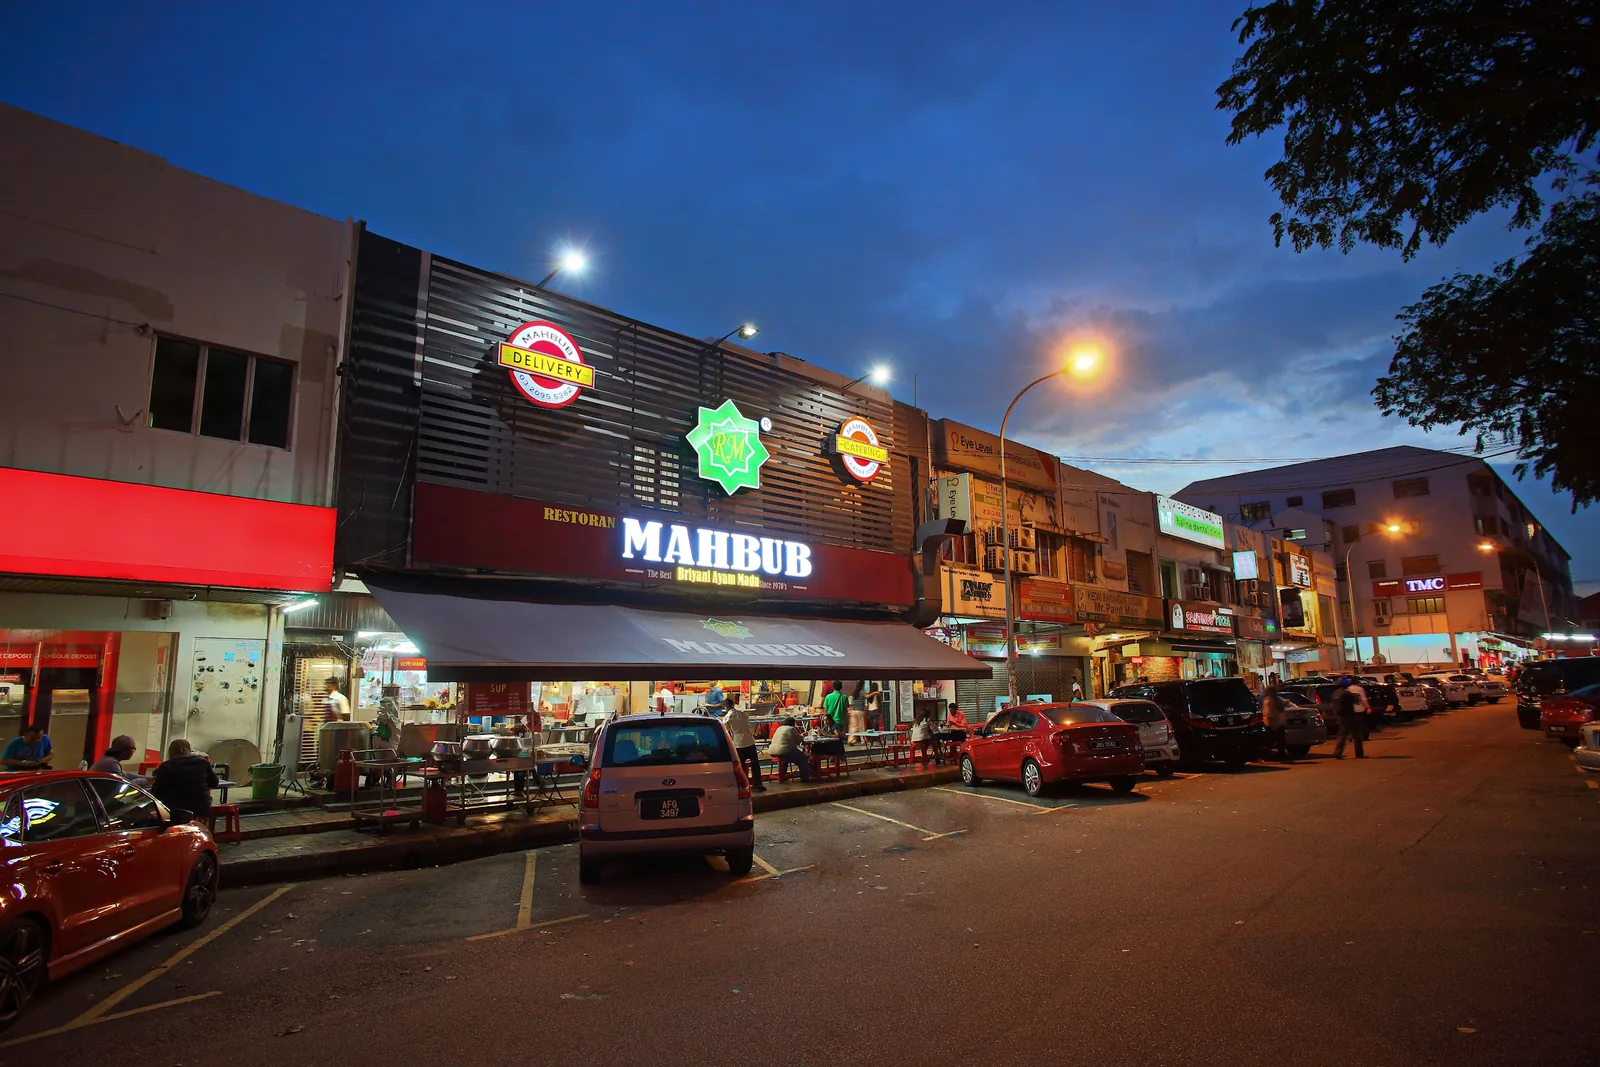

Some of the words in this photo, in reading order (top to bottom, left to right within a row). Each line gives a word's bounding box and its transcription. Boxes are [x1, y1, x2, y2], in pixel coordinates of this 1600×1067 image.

[521, 330, 574, 356] MAHBUB
[513, 351, 582, 380] DELIVERY
[712, 431, 747, 464] RM
[843, 441, 881, 458] CATERING
[960, 435, 974, 450] Eye
[975, 440, 993, 455] Level
[948, 490, 957, 505] Eye
[543, 506, 617, 529] RESTORAN
[621, 517, 813, 578] MAHBUB
[647, 569, 659, 578] The
[659, 570, 673, 580] Best
[676, 566, 711, 583] Briyani
[711, 570, 736, 586] Ayam
[737, 573, 760, 588] Madu
[1406, 577, 1444, 592] TMC
[1094, 601, 1105, 613] Mr.
[1106, 603, 1124, 615] Paint
[660, 637, 846, 657] MAHBUB
[490, 684, 507, 693] SUP
[660, 808, 680, 818] 3497
